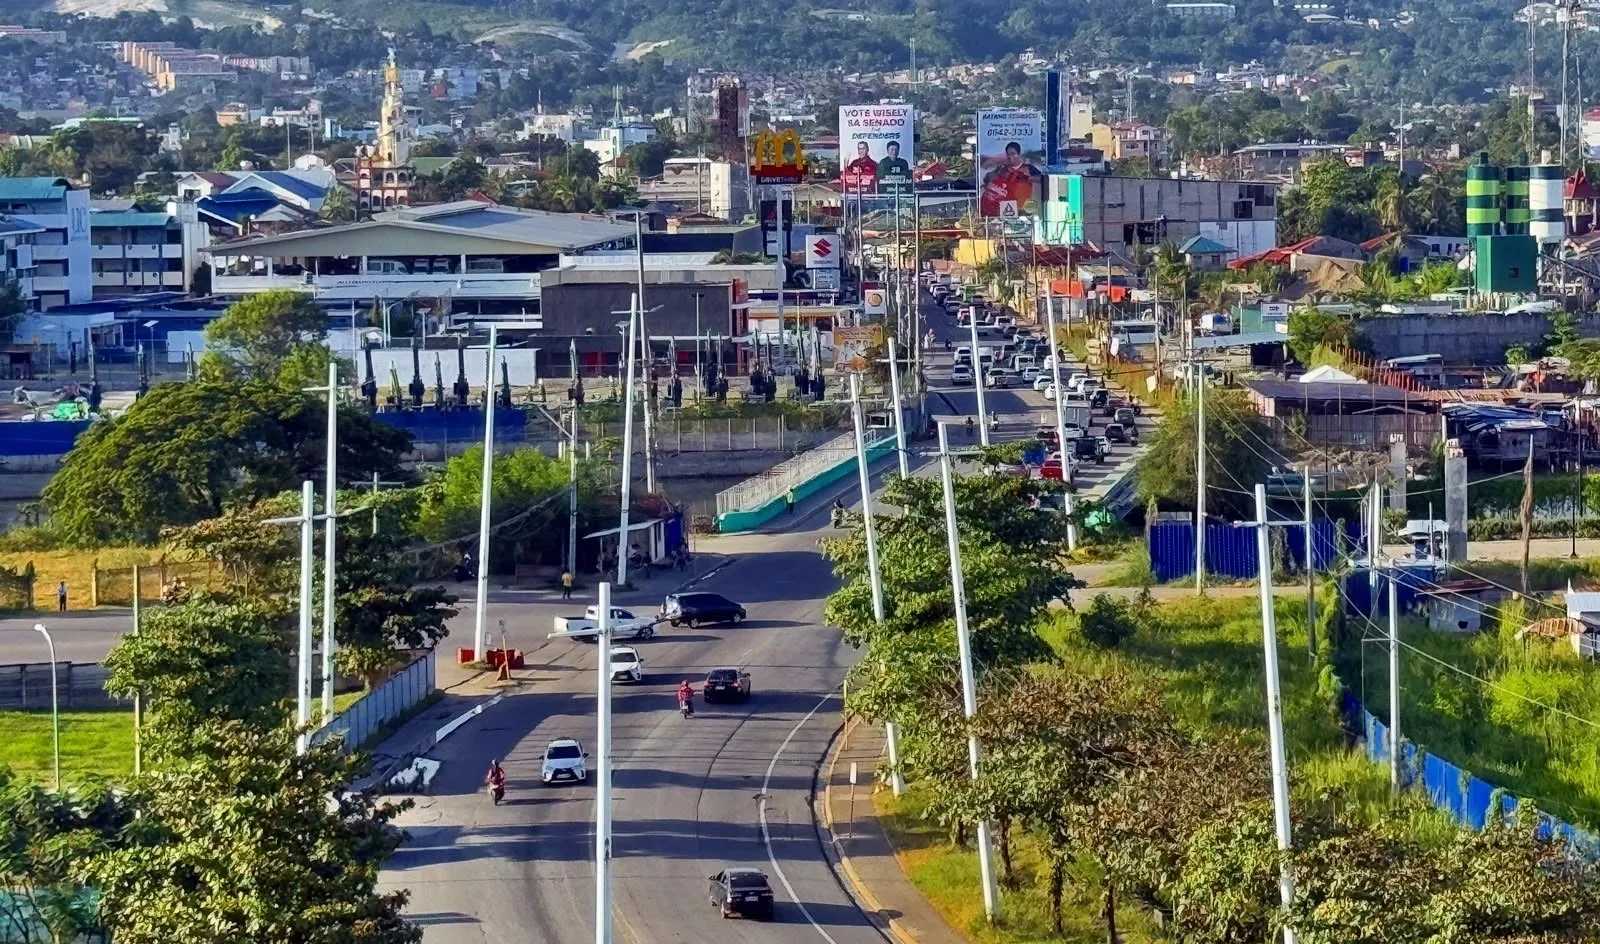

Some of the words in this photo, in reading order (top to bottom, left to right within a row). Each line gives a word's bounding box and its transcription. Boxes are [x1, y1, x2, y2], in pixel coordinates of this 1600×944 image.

[844, 109, 870, 117] VOTE
[872, 109, 908, 117] WISELY
[848, 119, 860, 127] SA
